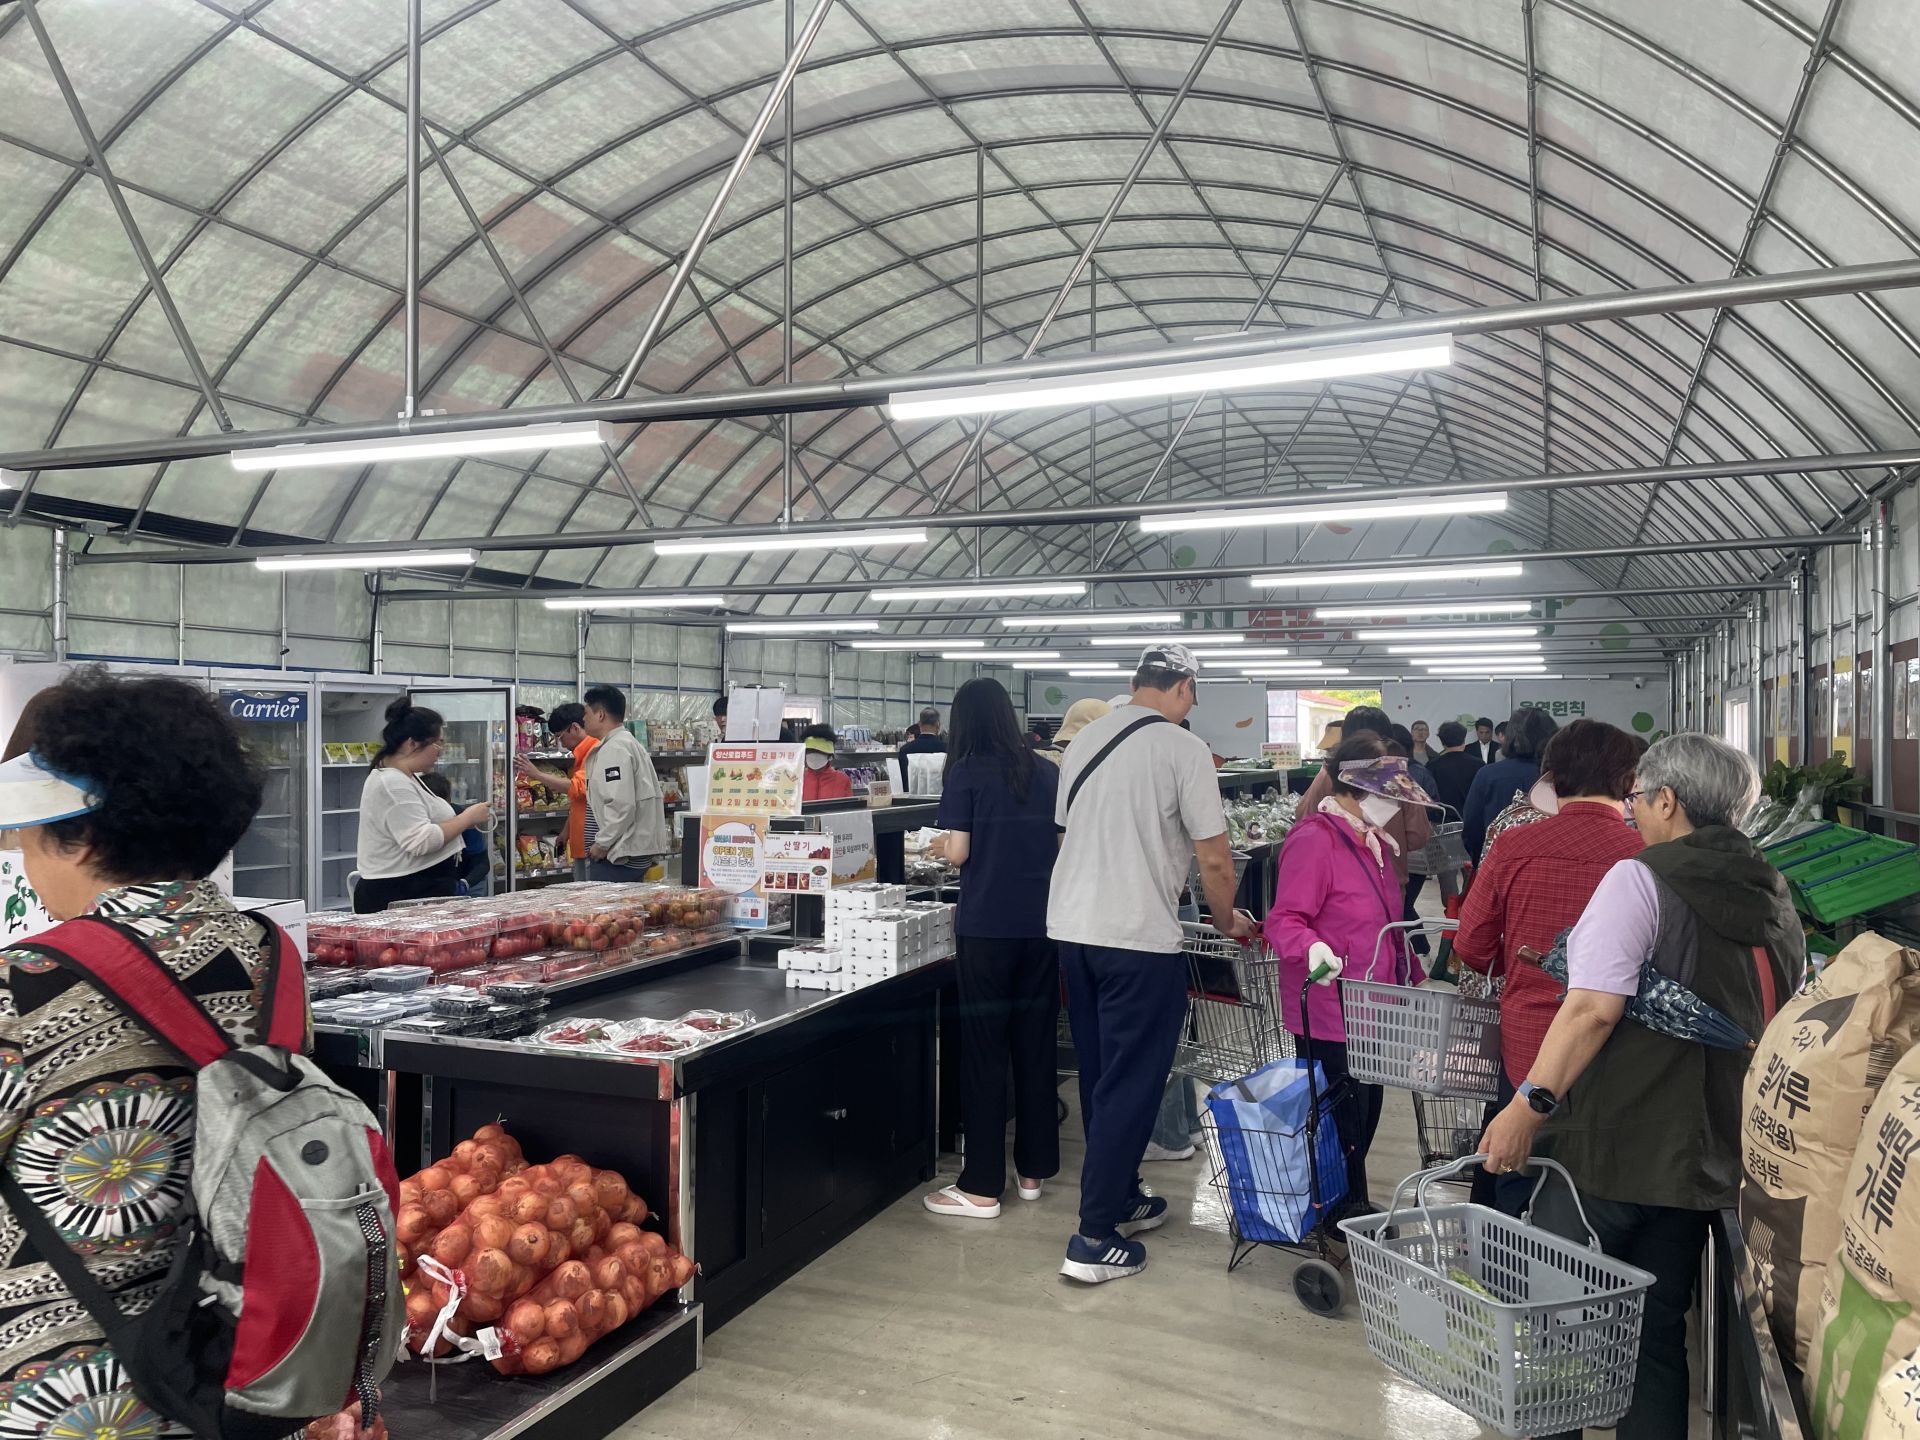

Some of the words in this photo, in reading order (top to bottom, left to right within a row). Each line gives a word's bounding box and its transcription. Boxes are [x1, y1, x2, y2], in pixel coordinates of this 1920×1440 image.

[230, 699, 300, 718] Carrier
[713, 846, 736, 856] OPEN
[784, 840, 810, 851] 산딸기
[1791, 1025, 1816, 1053] 우리
[1758, 1053, 1811, 1120] 밀가루
[1749, 1103, 1797, 1155] (다목적용)
[1748, 1148, 1783, 1190] 중력분
[1856, 1163, 1893, 1235] 가루
